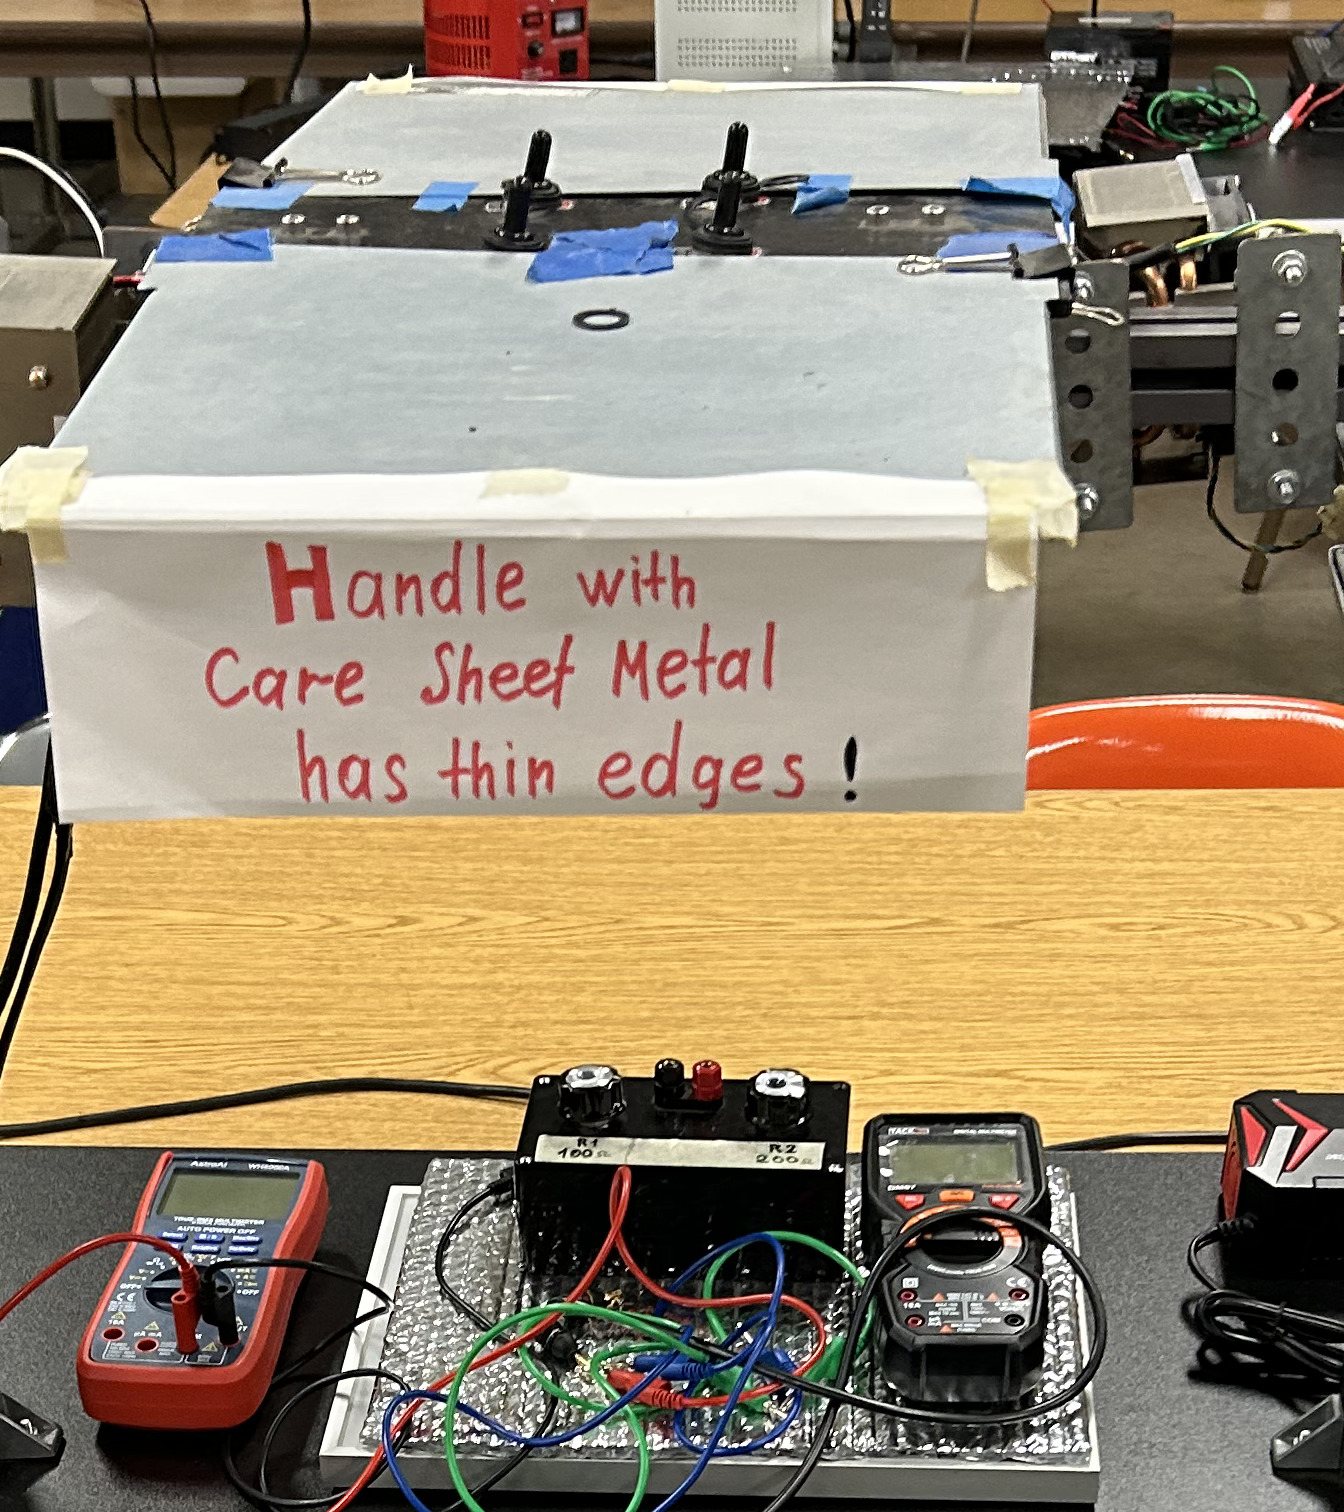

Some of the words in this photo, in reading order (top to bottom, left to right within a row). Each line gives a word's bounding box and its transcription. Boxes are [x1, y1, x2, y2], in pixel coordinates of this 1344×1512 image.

[265, 539, 526, 625] Handle
[576, 549, 696, 610] with
[205, 647, 365, 711] Care
[420, 634, 575, 711] Sheet
[612, 620, 776, 701] Metal
[296, 728, 408, 804] has
[438, 737, 554, 800] thin
[597, 718, 805, 811] edges
[577, 1137, 599, 1147] R1
[768, 1143, 797, 1154] R2
[177, 1225, 202, 1233] AUTO
[203, 1226, 237, 1234] POWER
